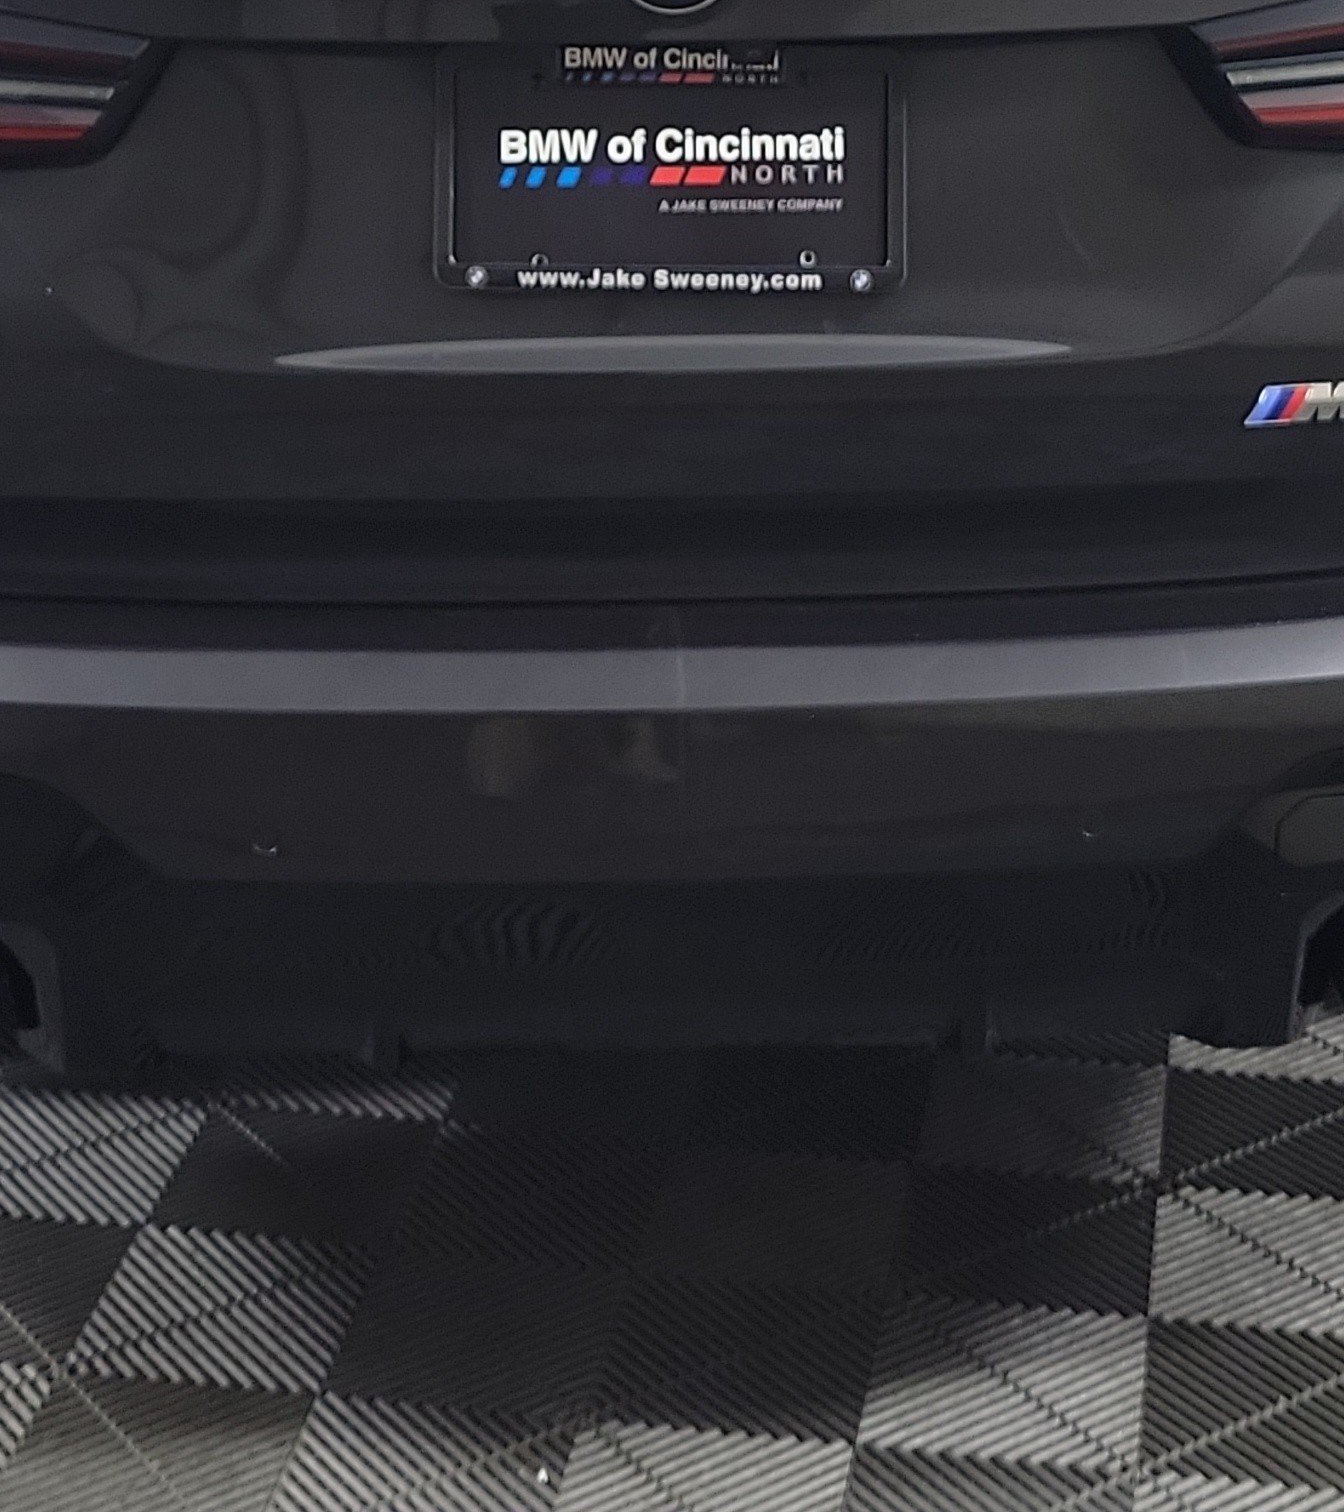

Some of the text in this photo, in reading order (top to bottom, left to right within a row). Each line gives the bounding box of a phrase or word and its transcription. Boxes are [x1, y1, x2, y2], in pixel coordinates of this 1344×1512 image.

[564, 47, 627, 69] BMW
[633, 47, 656, 69] of
[499, 127, 845, 163] BMW of Cincinnati
[730, 165, 843, 185] NORTH
[658, 198, 843, 213] A JAKE SWEENEY COMPANY
[517, 268, 822, 294] www.Jake Sweeney.com
